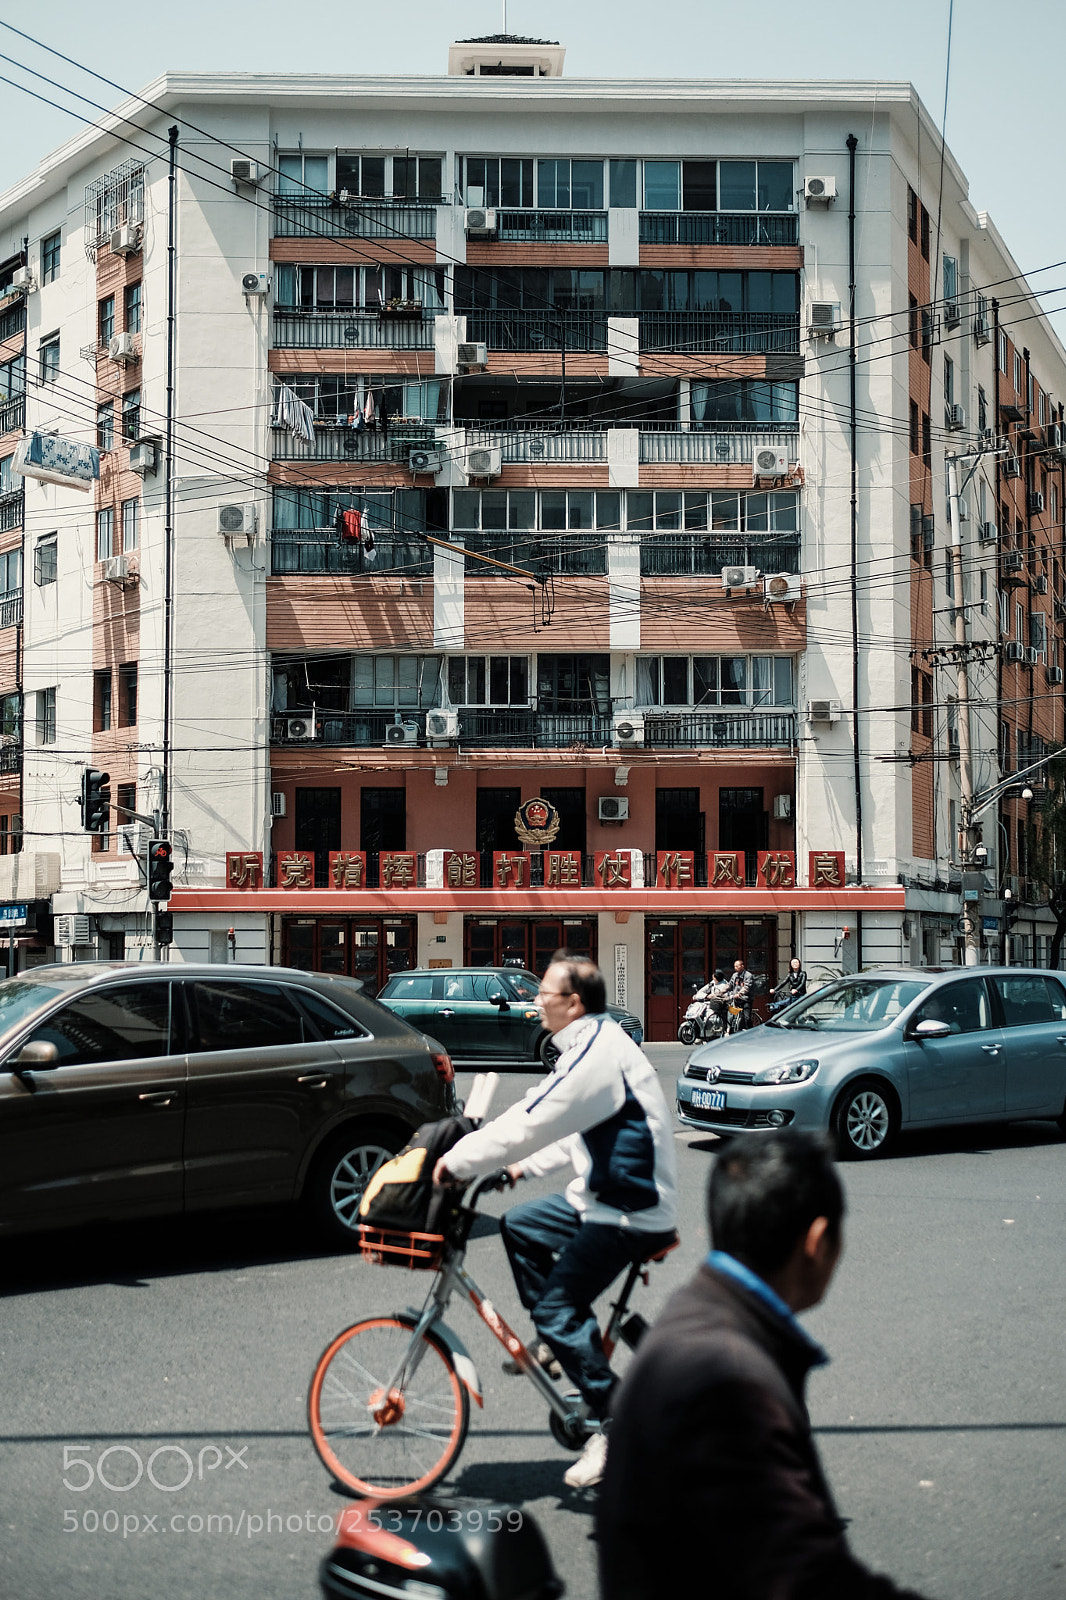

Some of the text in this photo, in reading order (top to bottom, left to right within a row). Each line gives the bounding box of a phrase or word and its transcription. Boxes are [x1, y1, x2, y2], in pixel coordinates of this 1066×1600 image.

[229, 852, 842, 888] 听党指挥 能打胜仗 作风优良
